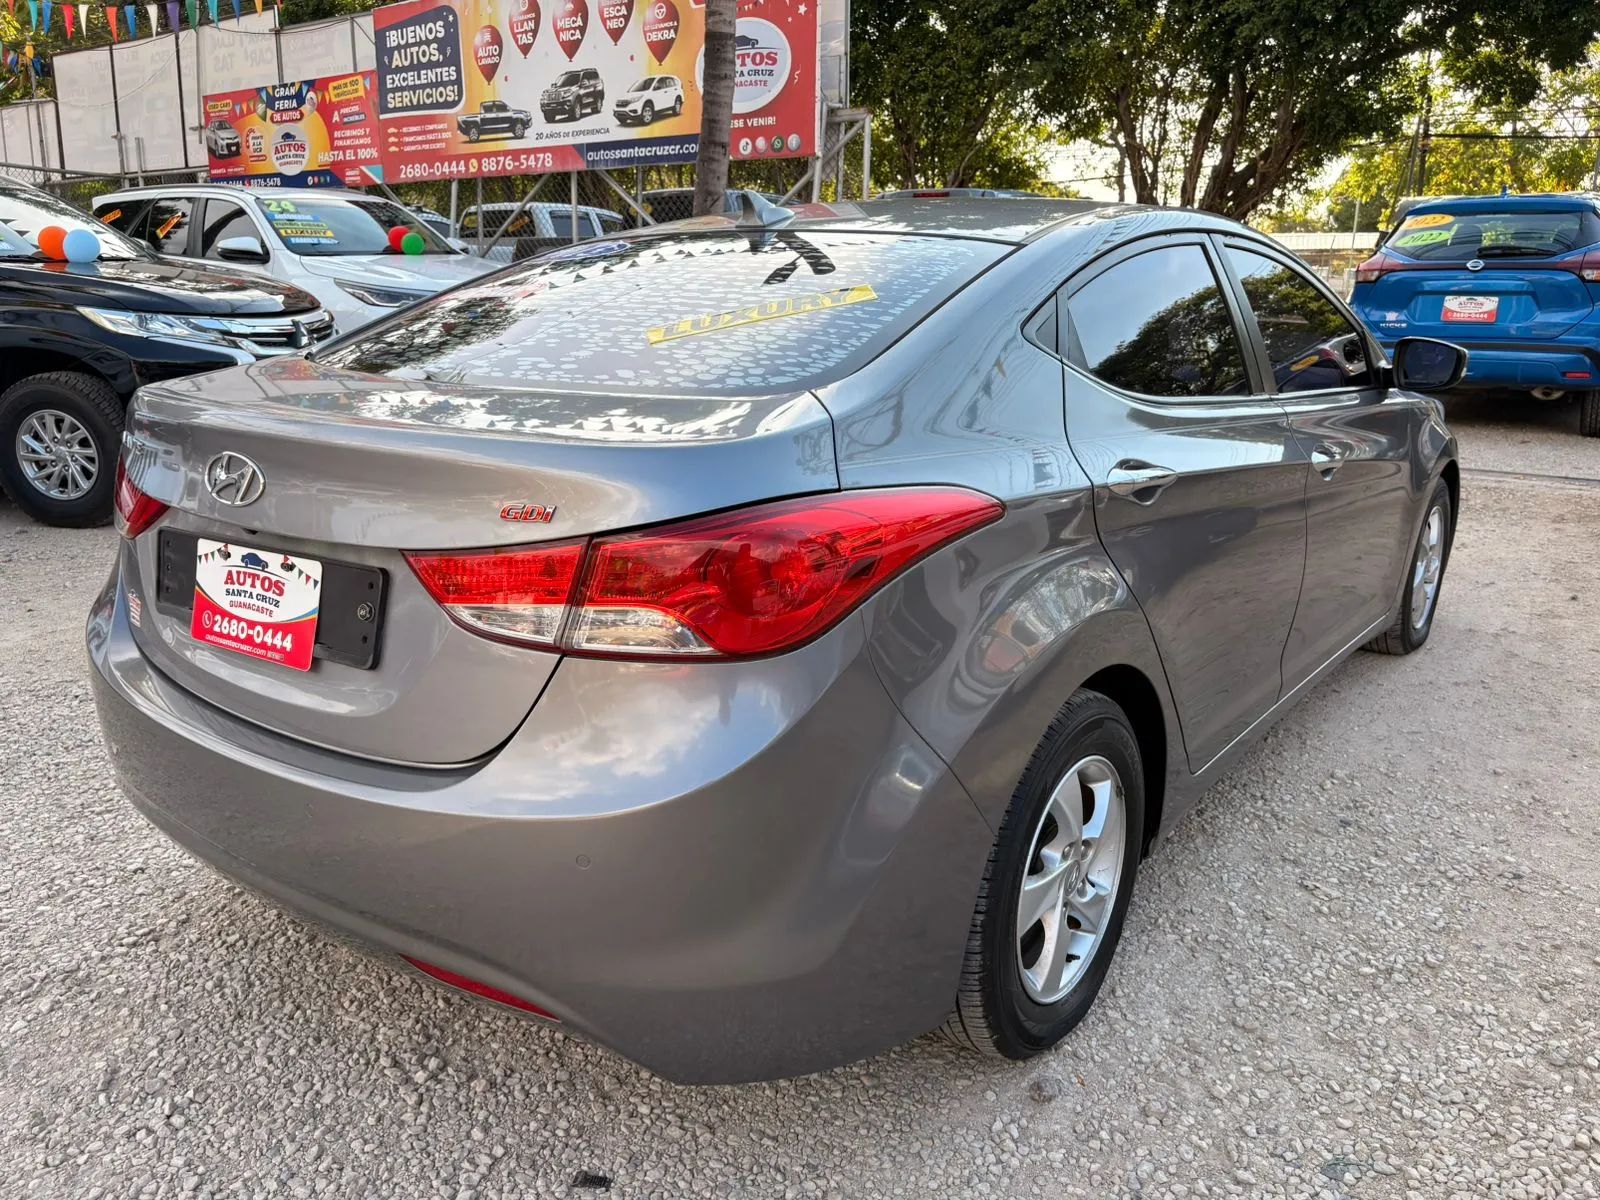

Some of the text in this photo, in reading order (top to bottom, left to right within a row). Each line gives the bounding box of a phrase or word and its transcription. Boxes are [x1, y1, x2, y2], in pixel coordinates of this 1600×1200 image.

[603, 5, 628, 18] ESCA
[513, 20, 535, 32] LLAN
[557, 13, 583, 30] MECÁ
[606, 18, 625, 30] NEO
[386, 20, 445, 48] ¡BUENOS
[516, 32, 533, 45] TAS
[559, 30, 582, 42] NICA
[646, 30, 676, 42] DEKRA
[391, 43, 443, 69] AUTOS,
[478, 45, 499, 58] AUTO
[478, 56, 500, 66] LAVADO
[736, 52, 778, 68] TOS
[386, 66, 457, 88] EXCELENTES
[748, 69, 774, 78] CRUZ
[349, 78, 359, 88] 100
[735, 80, 768, 88] NACASTE
[274, 86, 296, 98] GRAN
[387, 85, 459, 109] SERVICIOS!
[274, 98, 298, 110] FERIA
[340, 104, 360, 114] PRECIOS
[273, 112, 300, 122] DE AUTOS
[332, 110, 340, 124] A
[746, 116, 776, 126] VENIR!
[334, 128, 365, 138] RECIBIMOS
[536, 132, 544, 140] 20
[545, 130, 562, 139] AÑOS
[572, 128, 610, 137] EXPERIENCIA
[274, 142, 306, 155] AUTOS
[334, 136, 372, 148] FINANCIAMOS
[318, 147, 378, 163] HASTA EL 100%
[400, 153, 552, 178] 2680-0444 8876-5478
[1408, 216, 1446, 227] 2022
[1402, 232, 1442, 244] 2022
[663, 287, 856, 338] LUXURY
[500, 504, 556, 523] GDi
[224, 570, 286, 598] AUTOS
[225, 588, 280, 608] SANTA CRUZ
[229, 600, 274, 618] GUANACASTE
[213, 614, 292, 652] 2680-0444
[205, 634, 267, 656] autossantacruzcr.com
